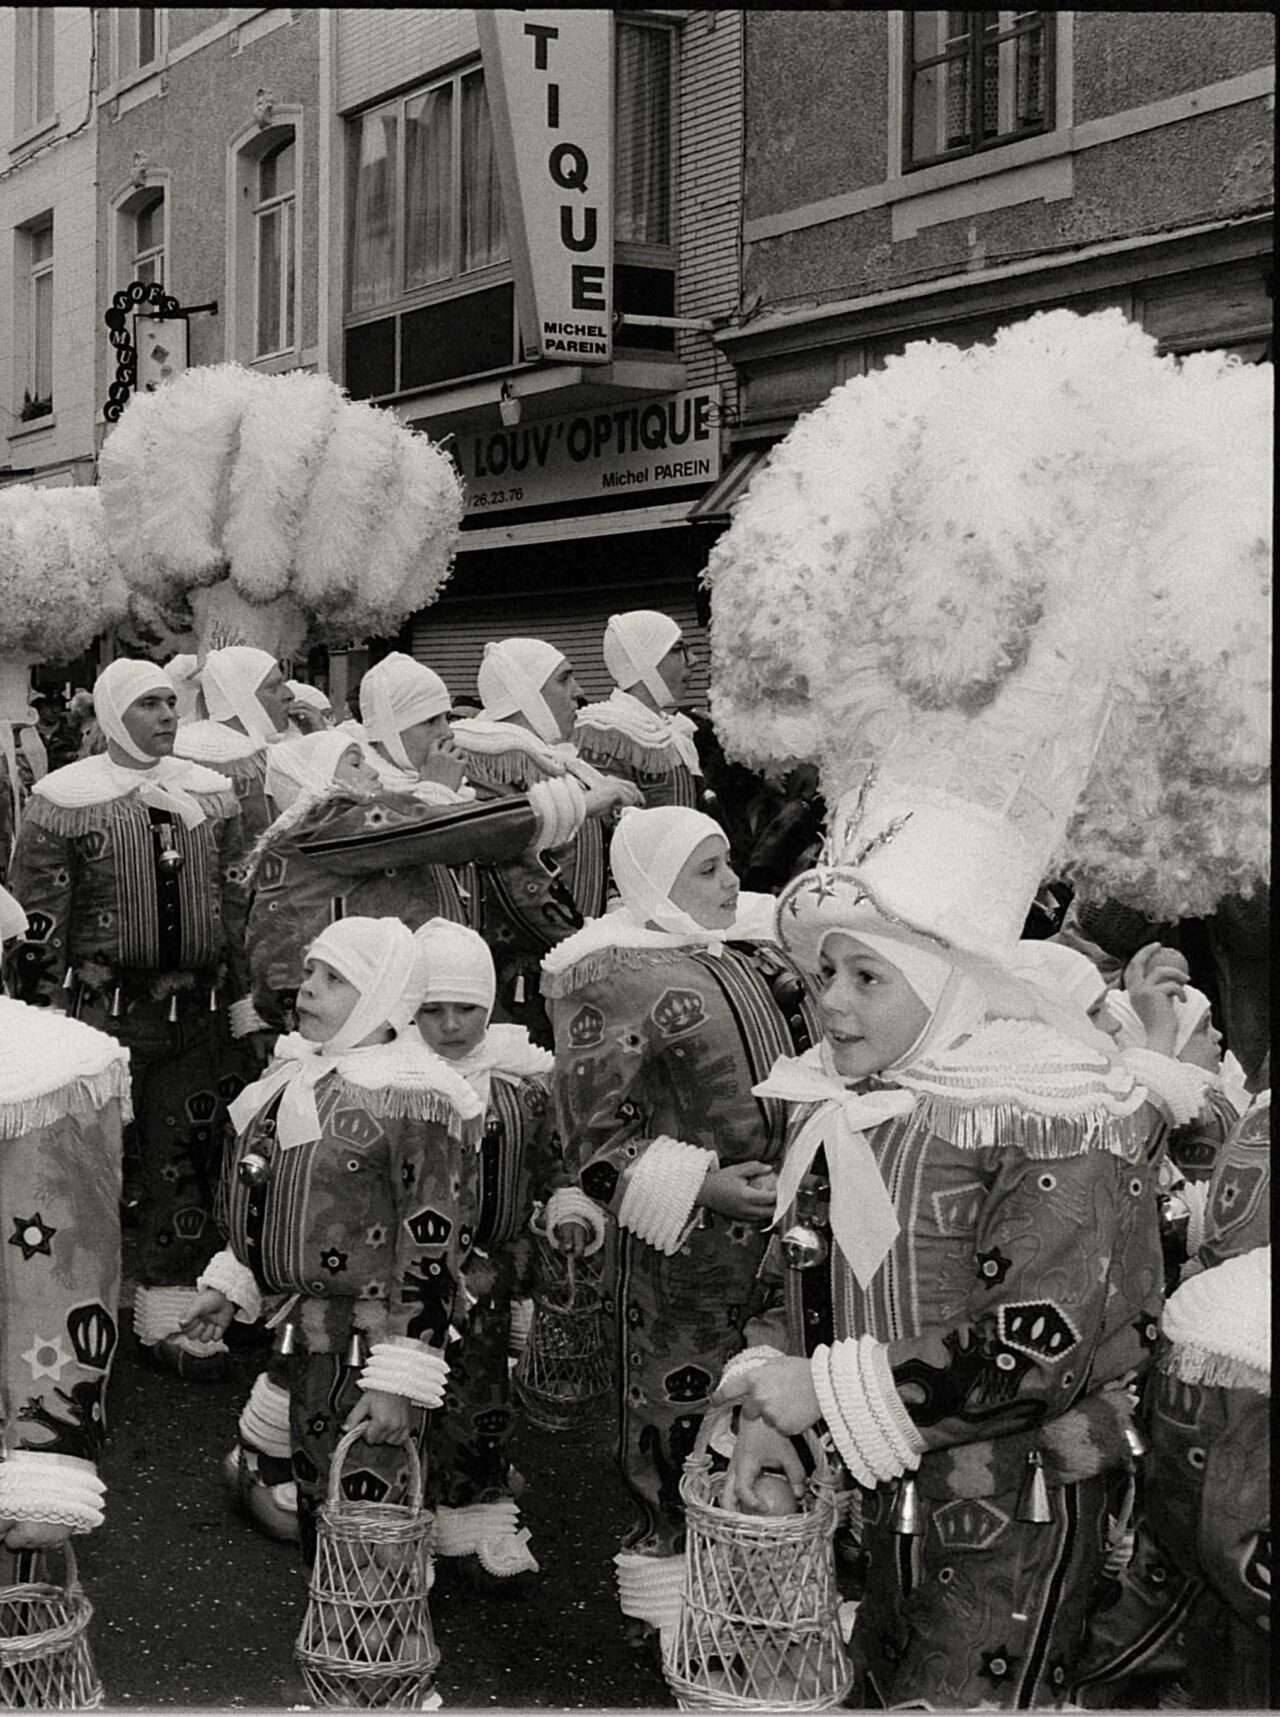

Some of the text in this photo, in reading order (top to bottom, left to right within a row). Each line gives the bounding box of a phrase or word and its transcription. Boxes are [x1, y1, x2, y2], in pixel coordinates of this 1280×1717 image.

[524, 23, 606, 311] TIQUE
[544, 322, 607, 338] MICHEL
[545, 339, 607, 354] PAREIN
[108, 331, 133, 419] MUSIC
[474, 394, 710, 478] LOUV'OPTIQUE
[602, 458, 710, 489] Michel PAREIN
[463, 487, 524, 509] /26.23.76
